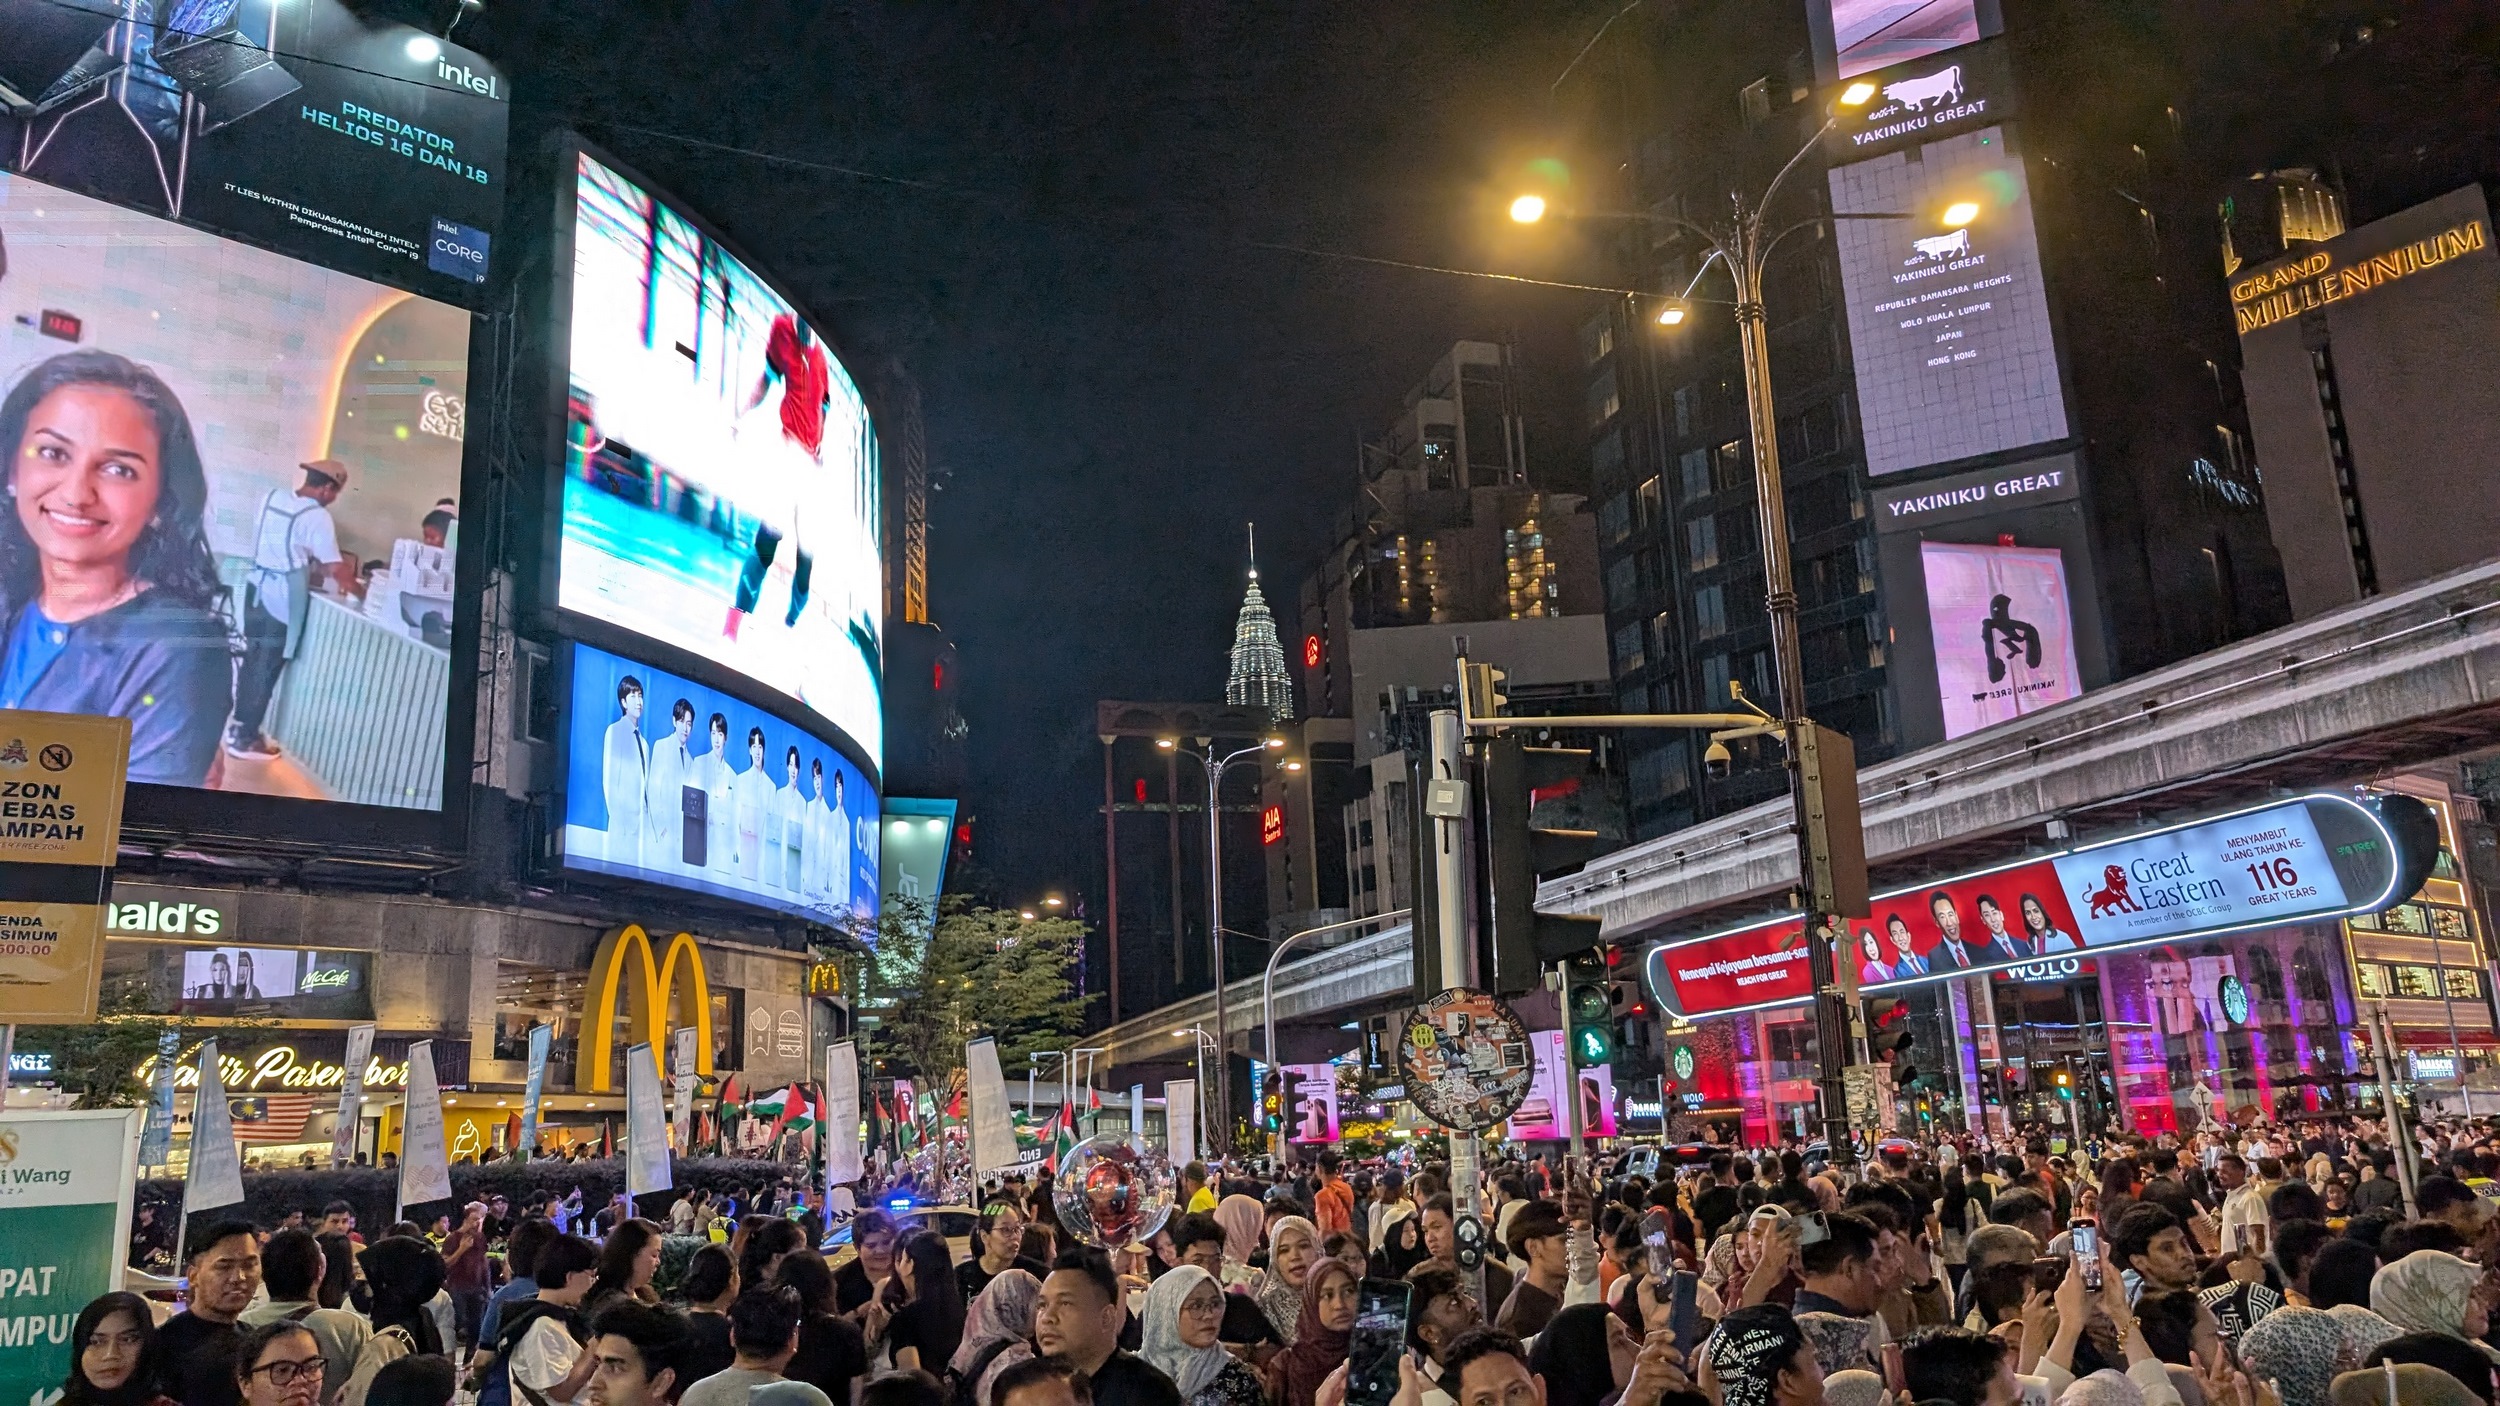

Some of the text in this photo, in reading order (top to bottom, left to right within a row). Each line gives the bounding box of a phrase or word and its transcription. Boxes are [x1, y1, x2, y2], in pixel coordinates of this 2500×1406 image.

[342, 101, 455, 154] PREDATOR
[1853, 100, 1986, 146] YAKINIKU GREAT
[302, 105, 488, 184] HELIOS 16 DAN 18
[224, 183, 236, 192] IT
[238, 186, 260, 199] LIES
[262, 194, 300, 213] WITHIN
[301, 206, 361, 233] DIKUASAKAN
[363, 227, 387, 241] OLEH
[290, 213, 344, 236] Pemproses
[409, 250, 419, 260] i9
[476, 274, 485, 284] i9
[1893, 254, 1986, 284] YAKINIKU GREAT
[2232, 251, 2332, 302] GRAND
[2237, 219, 2485, 335] MILLENNIUM
[1874, 274, 2012, 313] REPUBLIK DAMANSARA HEIGHTS
[1900, 302, 1992, 329] WOLO KUALA LUMPUR
[1935, 330, 1963, 343] JAPAN
[1927, 350, 1977, 367] HONG KONG
[1888, 471, 2063, 517] YAKINIKU GREAT
[1, 781, 61, 800] ZON
[1264, 807, 1280, 832] AIA
[2220, 838, 2307, 863] ULANG TAHUN KE-
[2226, 827, 2287, 849] MENYAMBUT
[2130, 851, 2195, 884] Great
[2246, 857, 2298, 891] 116
[2138, 878, 2226, 911] Eastern
[2248, 886, 2317, 907] GREAT YEARS
[2127, 903, 2232, 928] A member of the OCBC Group
[1678, 962, 1716, 982] Mencapai
[1716, 957, 1753, 976] Kejayaan
[1736, 969, 1788, 987] REACH FOR GREAT
[13, 1168, 72, 1186] Wang
[1740, 1335, 1785, 1358] ARMANI
